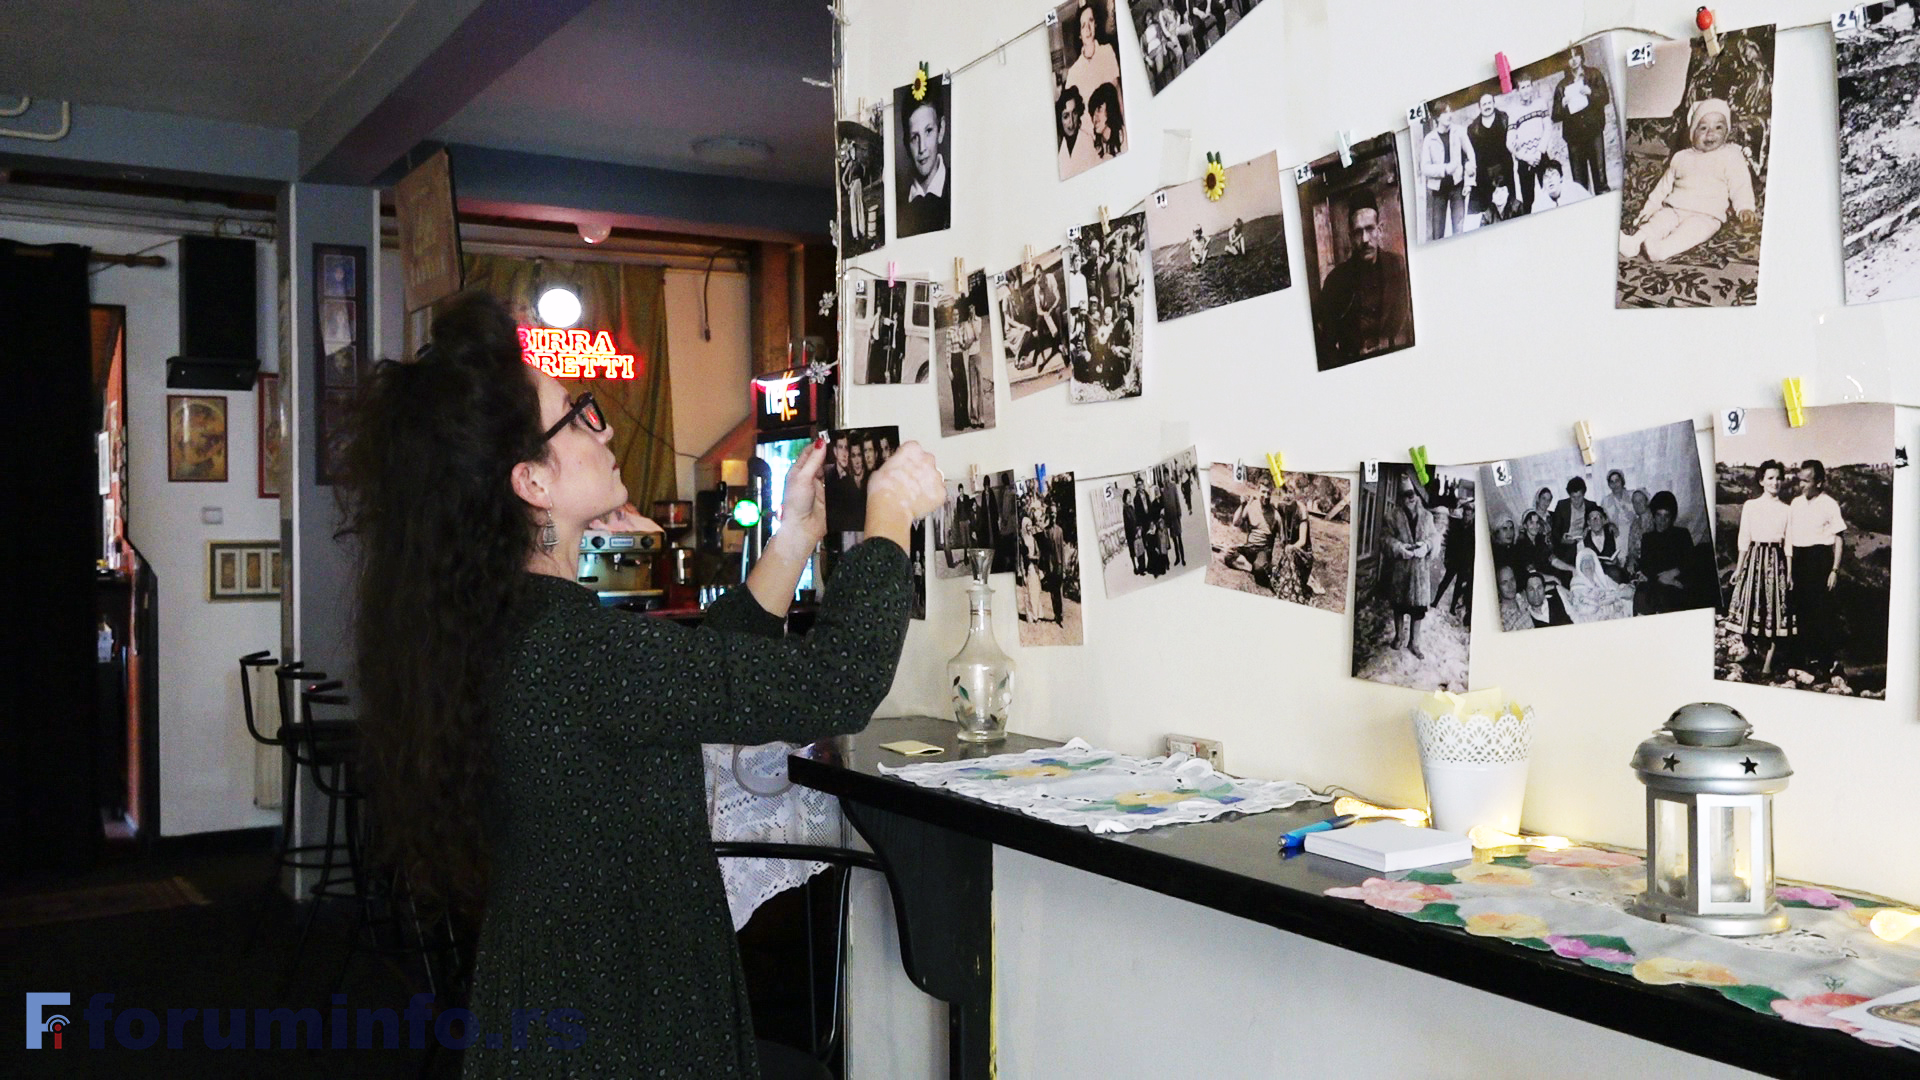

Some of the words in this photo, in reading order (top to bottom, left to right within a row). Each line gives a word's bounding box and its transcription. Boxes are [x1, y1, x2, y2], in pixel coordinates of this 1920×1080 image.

[1837, 10, 1857, 29] 24
[1297, 165, 1308, 180] 27
[517, 328, 616, 355] BIRRA
[1727, 411, 1739, 431] 9
[1105, 485, 1113, 498] 5
